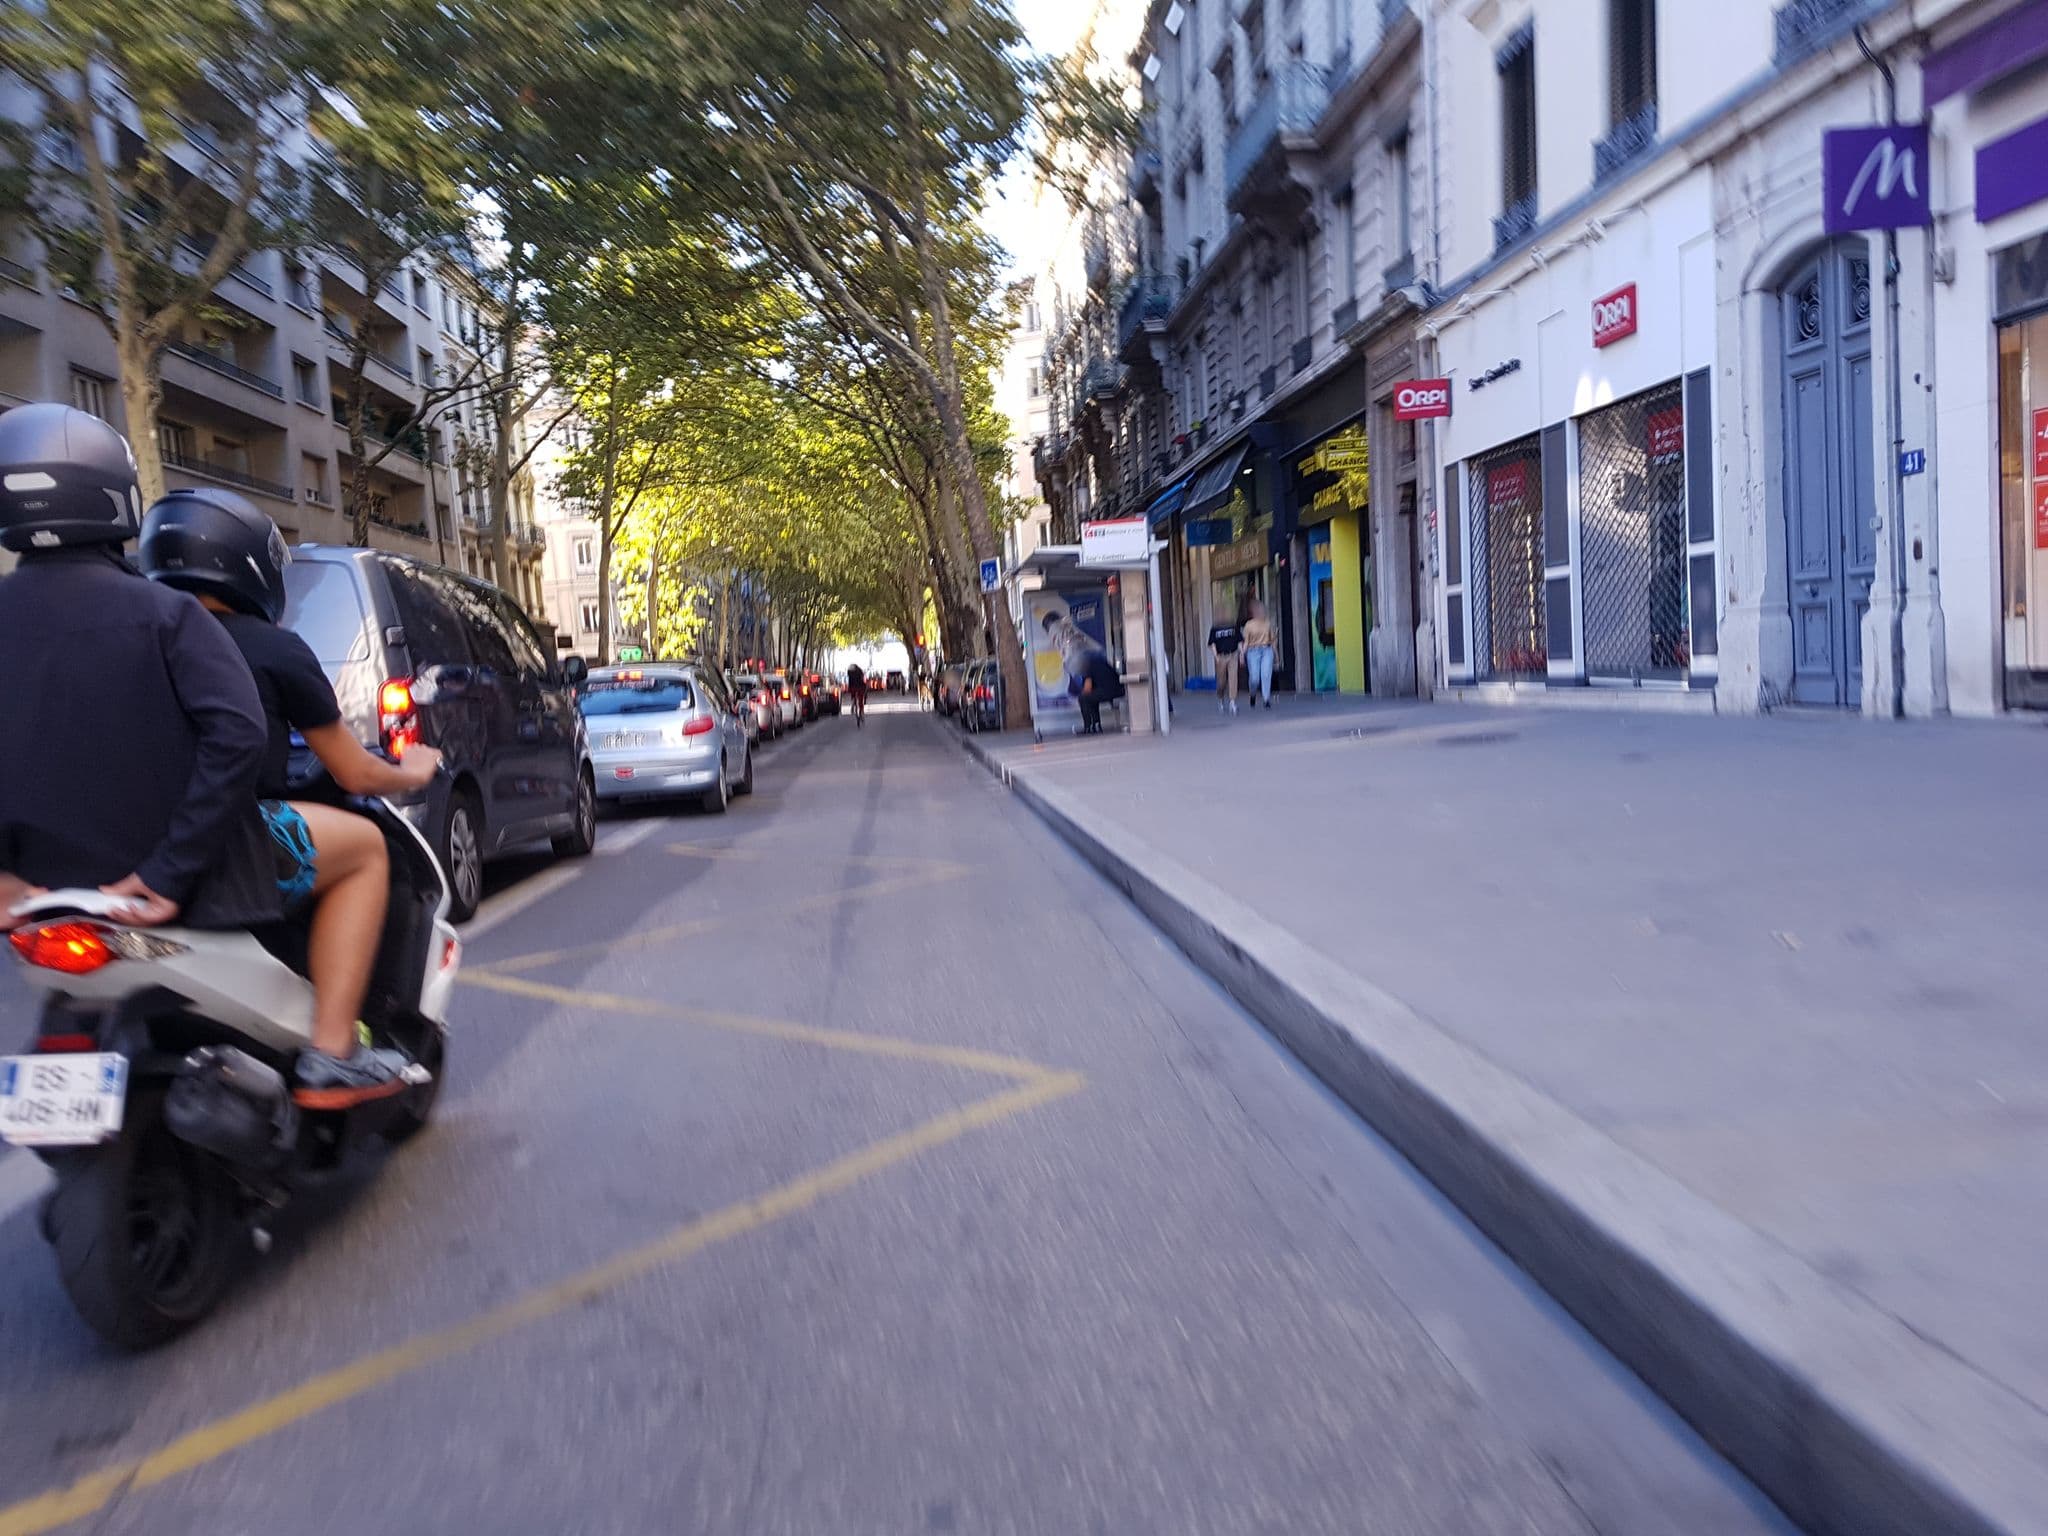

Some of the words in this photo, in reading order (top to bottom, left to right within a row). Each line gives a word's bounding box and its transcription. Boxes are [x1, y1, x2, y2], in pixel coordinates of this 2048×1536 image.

[1592, 294, 1630, 332] ORPI
[1398, 388, 1448, 408] ORPI
[1904, 452, 1919, 471] 41
